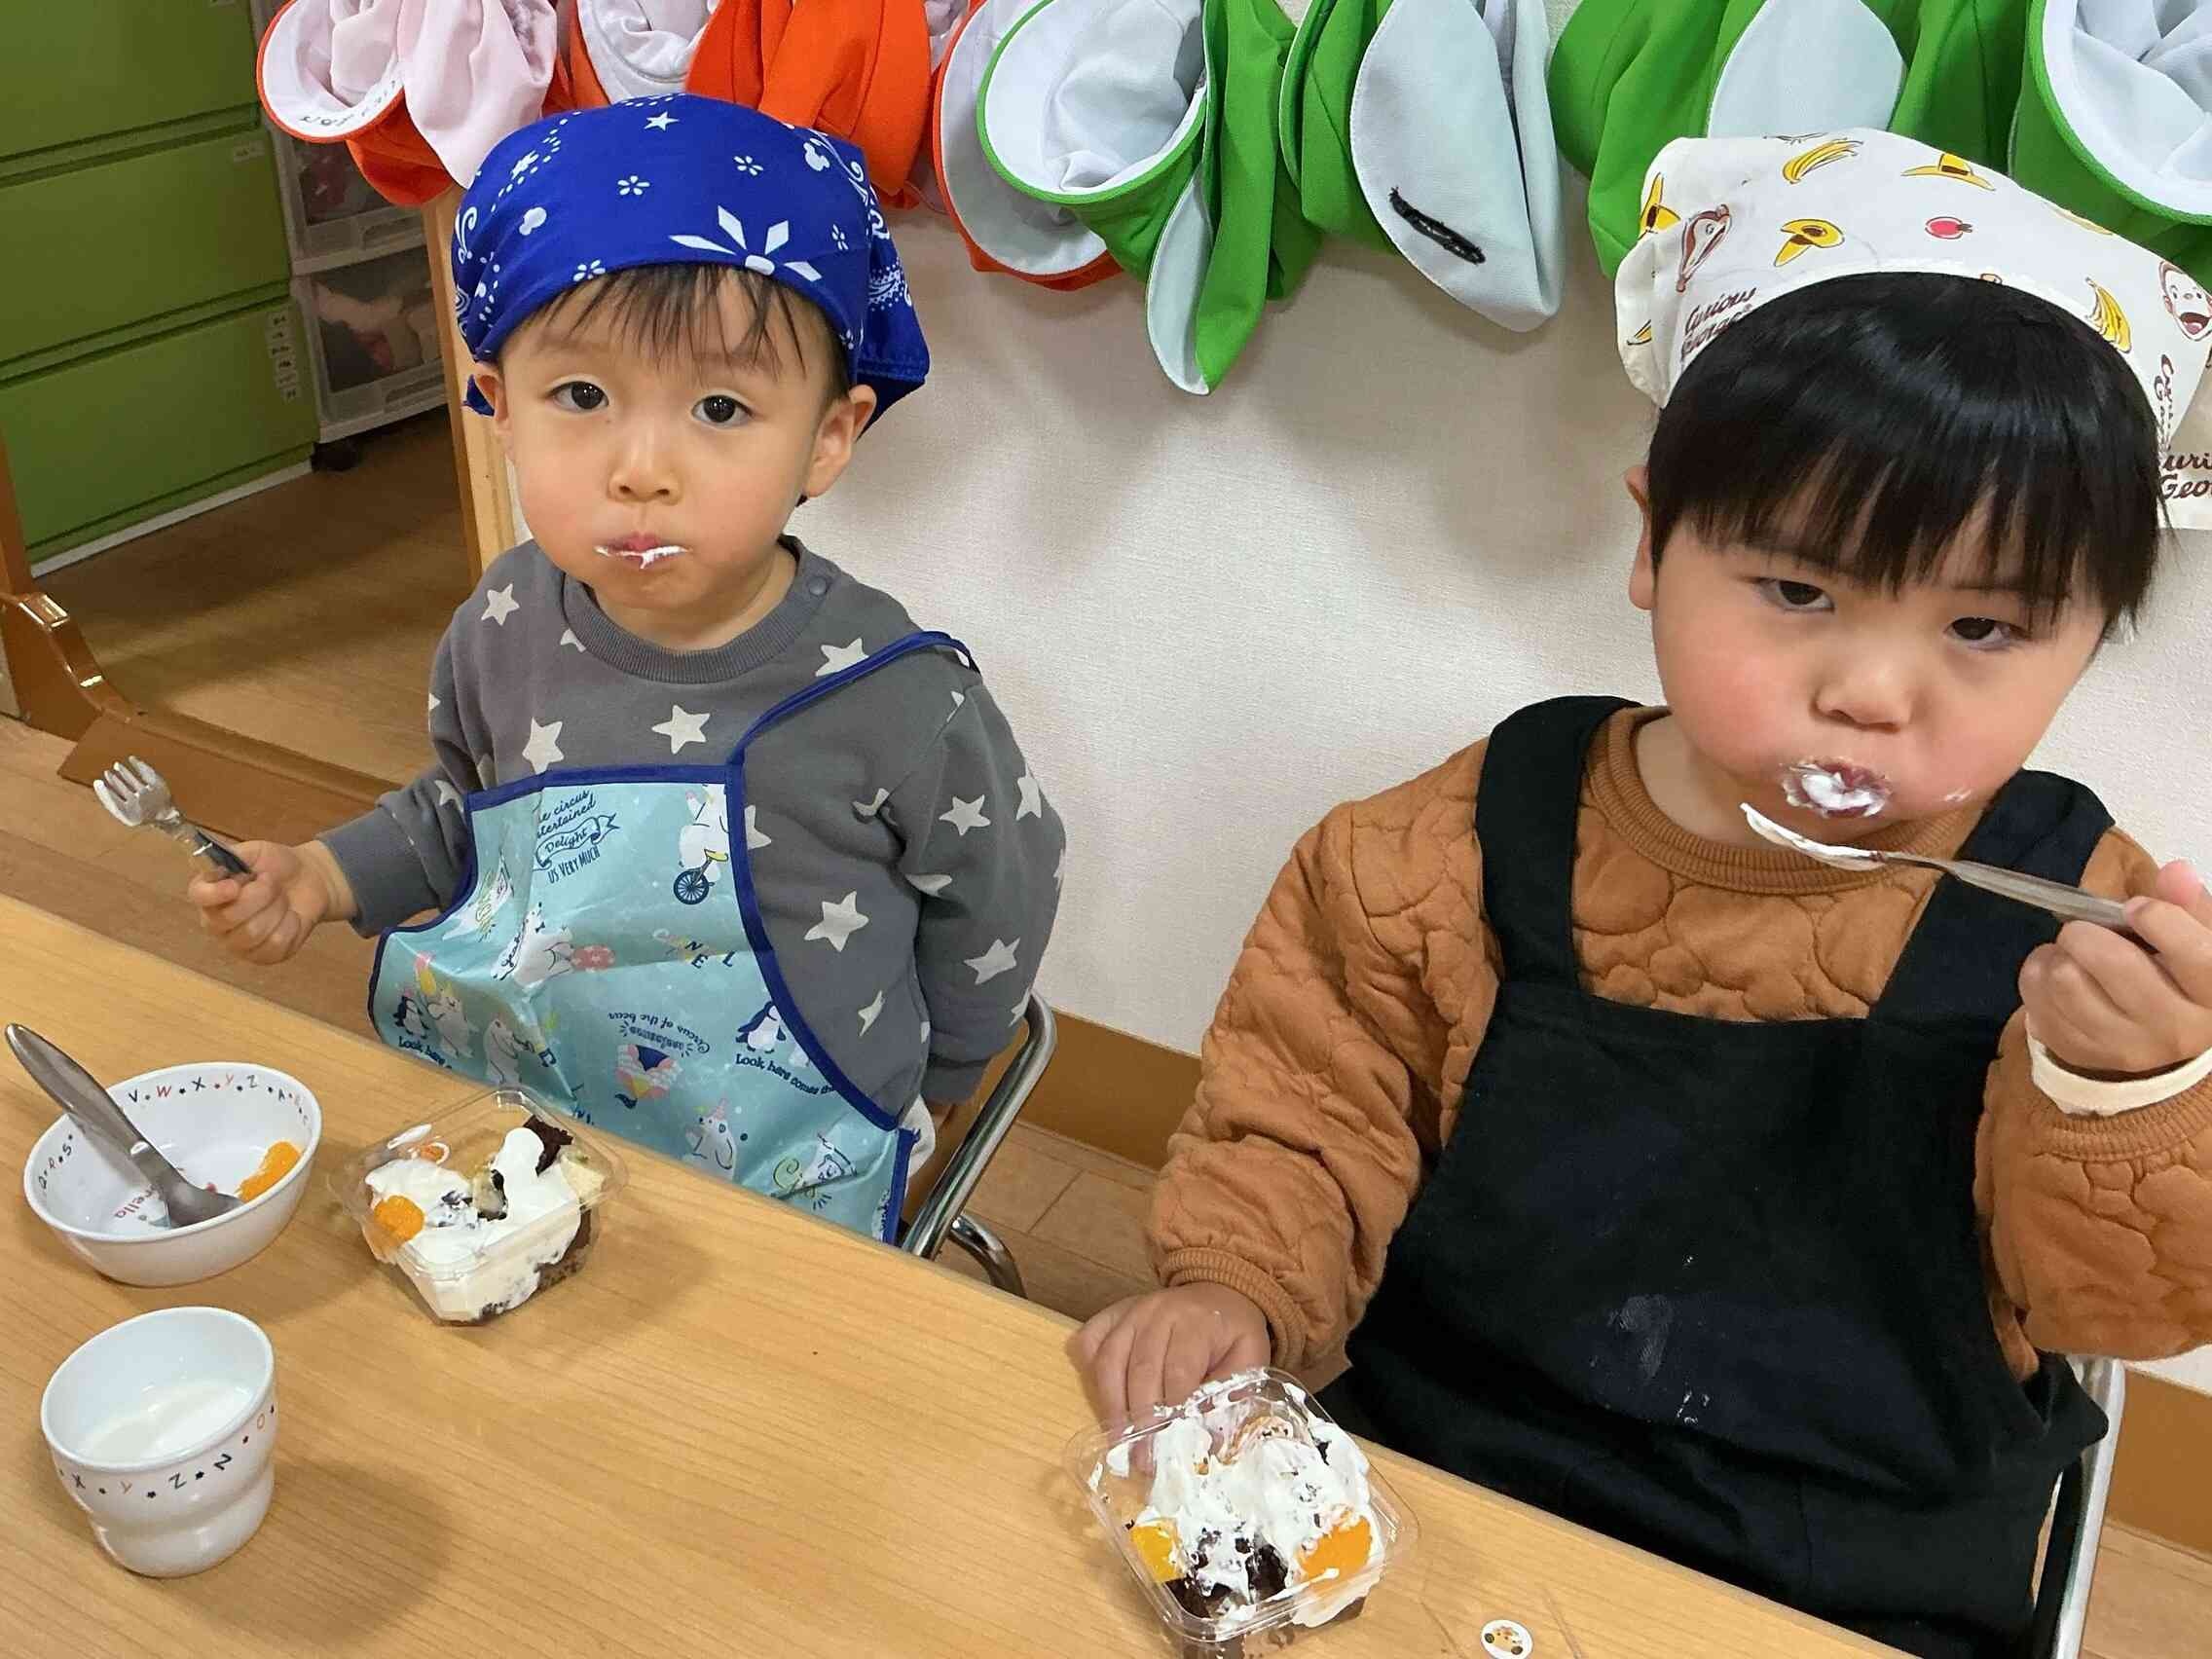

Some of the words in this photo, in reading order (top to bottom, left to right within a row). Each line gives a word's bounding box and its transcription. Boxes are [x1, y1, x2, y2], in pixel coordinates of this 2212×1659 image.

[2162, 452, 2212, 472] uri
[2160, 474, 2212, 499] Geo
[554, 790, 590, 816] circus
[544, 828, 589, 853] Delight
[558, 857, 580, 877] VERY
[578, 845, 601, 868] MUCH
[735, 1053, 765, 1069] Look
